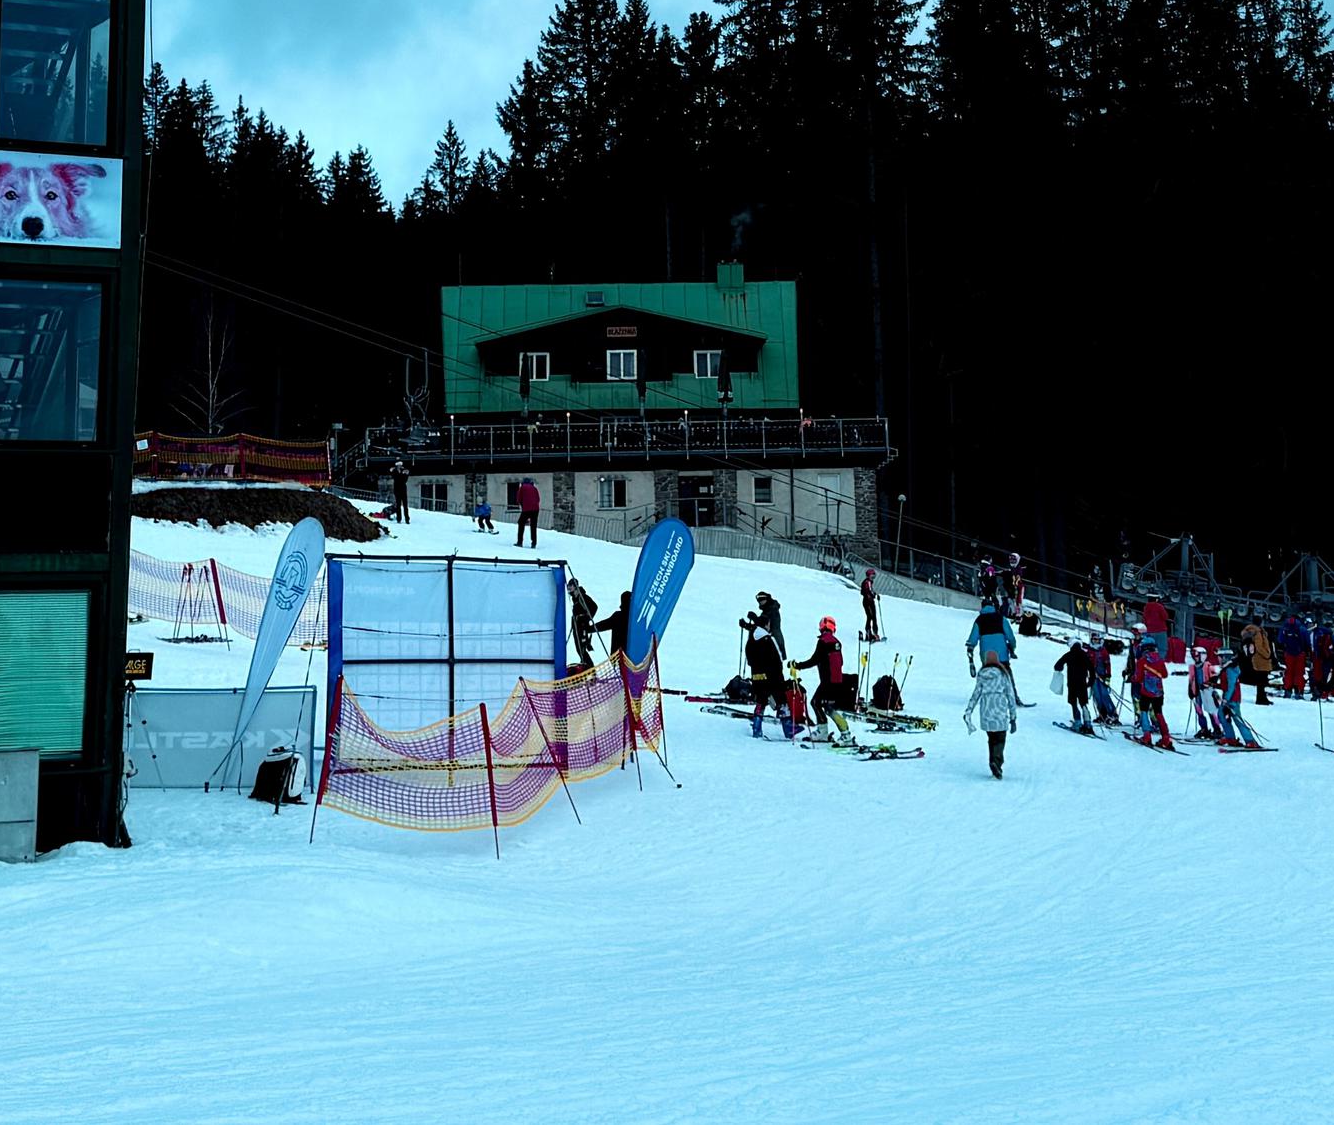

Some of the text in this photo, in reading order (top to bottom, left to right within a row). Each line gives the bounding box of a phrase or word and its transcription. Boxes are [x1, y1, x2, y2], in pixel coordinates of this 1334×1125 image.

[648, 550, 672, 598] CZECH SKI
[657, 536, 684, 595] SNOWBOARD
